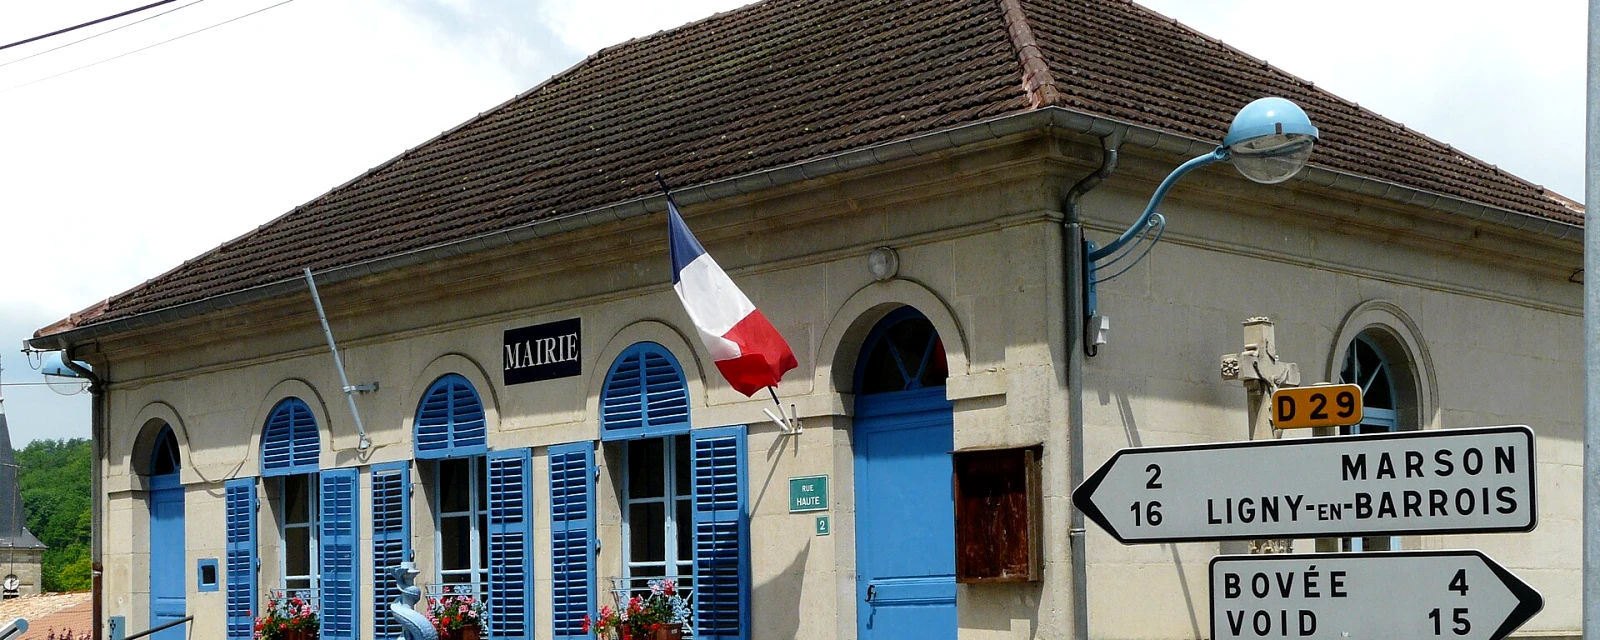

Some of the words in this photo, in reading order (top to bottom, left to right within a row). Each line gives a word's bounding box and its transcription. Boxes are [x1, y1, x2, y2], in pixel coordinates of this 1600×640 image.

[504, 331, 579, 371] MAIRIE
[1277, 394, 1297, 422] D
[1309, 391, 1356, 421] 29
[1145, 463, 1163, 490] 2
[1341, 445, 1517, 482] MARSON
[796, 496, 821, 507] HAUTE
[801, 484, 815, 492] RUE
[1130, 500, 1164, 527] 16
[1207, 486, 1519, 526] LIGNY-EN-BARROIS
[819, 520, 826, 531] 2
[1224, 565, 1348, 599] BOVÉE
[1448, 568, 1470, 597] 4
[1226, 609, 1318, 637] VOID
[1428, 607, 1472, 636] 15
